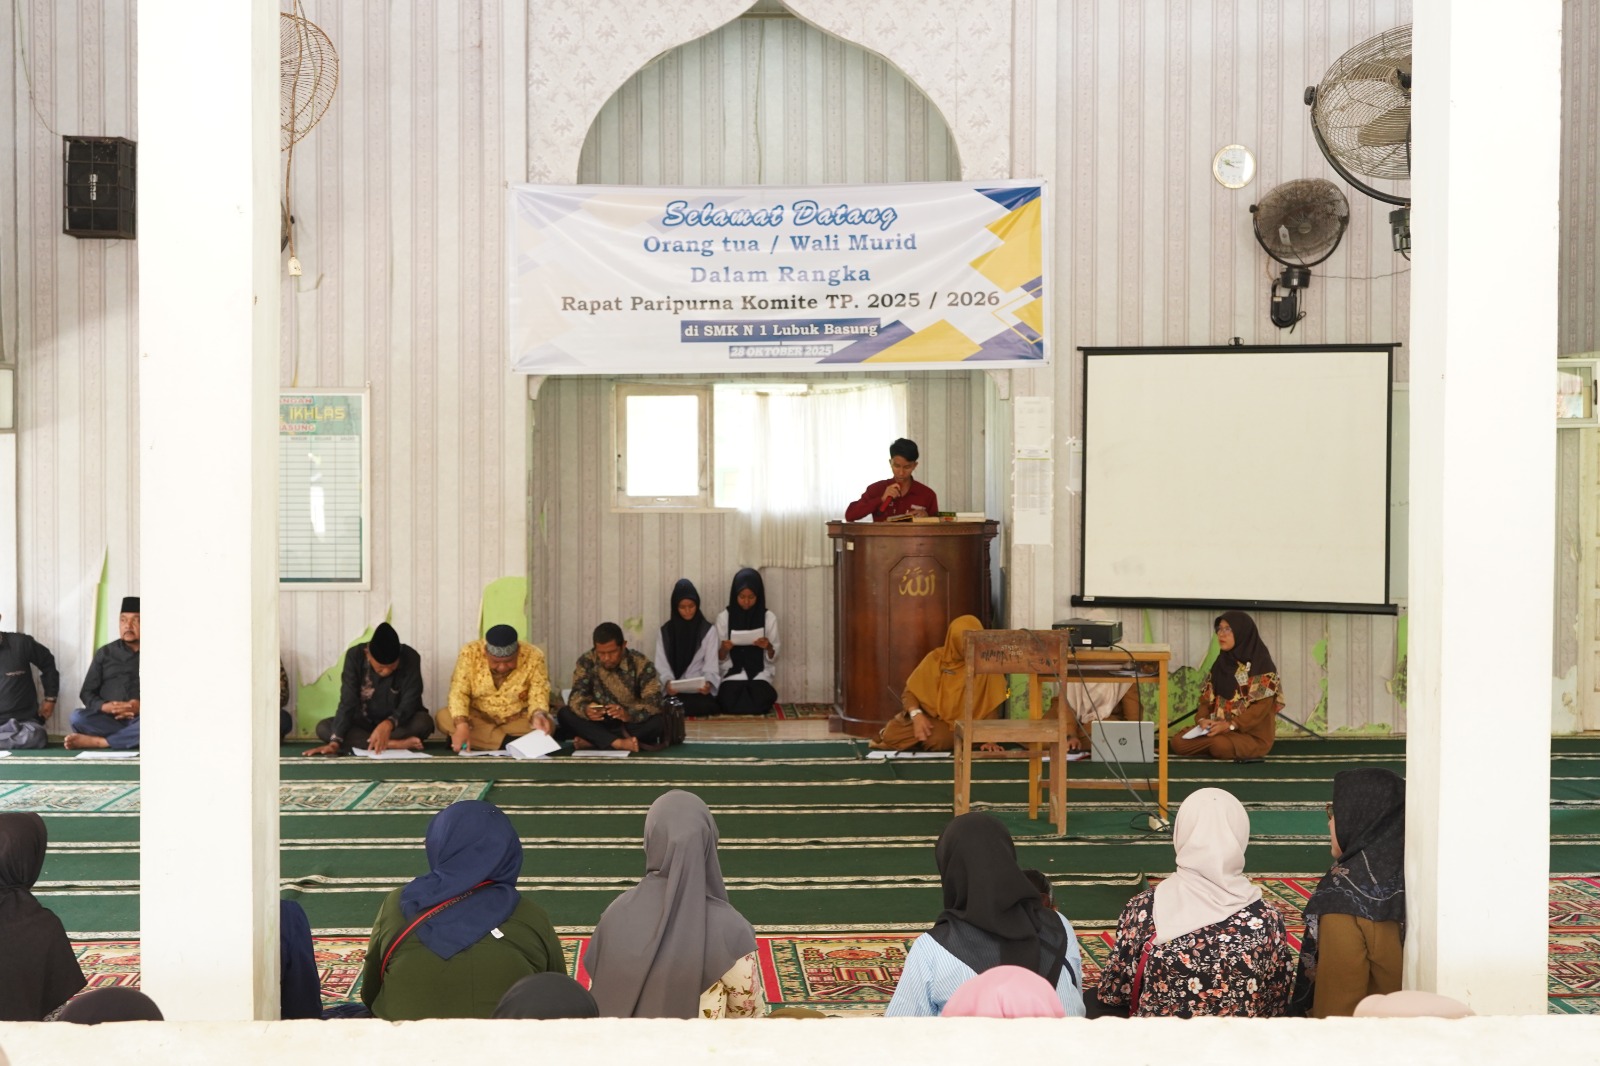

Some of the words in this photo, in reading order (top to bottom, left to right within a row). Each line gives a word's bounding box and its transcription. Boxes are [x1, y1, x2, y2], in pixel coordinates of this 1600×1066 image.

[662, 200, 784, 227] Selamat
[792, 200, 898, 231] Datang
[643, 236, 714, 257] Orang
[722, 236, 760, 252] tua
[769, 235, 780, 255] /
[789, 234, 840, 251] Wali
[848, 233, 917, 251] Murid
[690, 266, 769, 283] Dalam
[778, 265, 871, 286] Rangka
[561, 296, 623, 315] Rapat
[630, 296, 734, 314] Paripurna
[741, 295, 818, 310] Komite
[825, 294, 860, 309] TP.
[867, 293, 921, 309] 2025
[928, 291, 938, 310] /
[946, 291, 1000, 307] 2026
[684, 325, 700, 337] di
[703, 324, 739, 337] SMK
[742, 324, 755, 336] N
[759, 324, 768, 336] 1
[772, 323, 820, 337] Lubuk
[823, 322, 878, 337] Basung
[730, 346, 746, 357] 28
[746, 345, 803, 357] OKTOBER
[803, 345, 833, 356] 2025
[289, 406, 345, 421] IKHLAS
